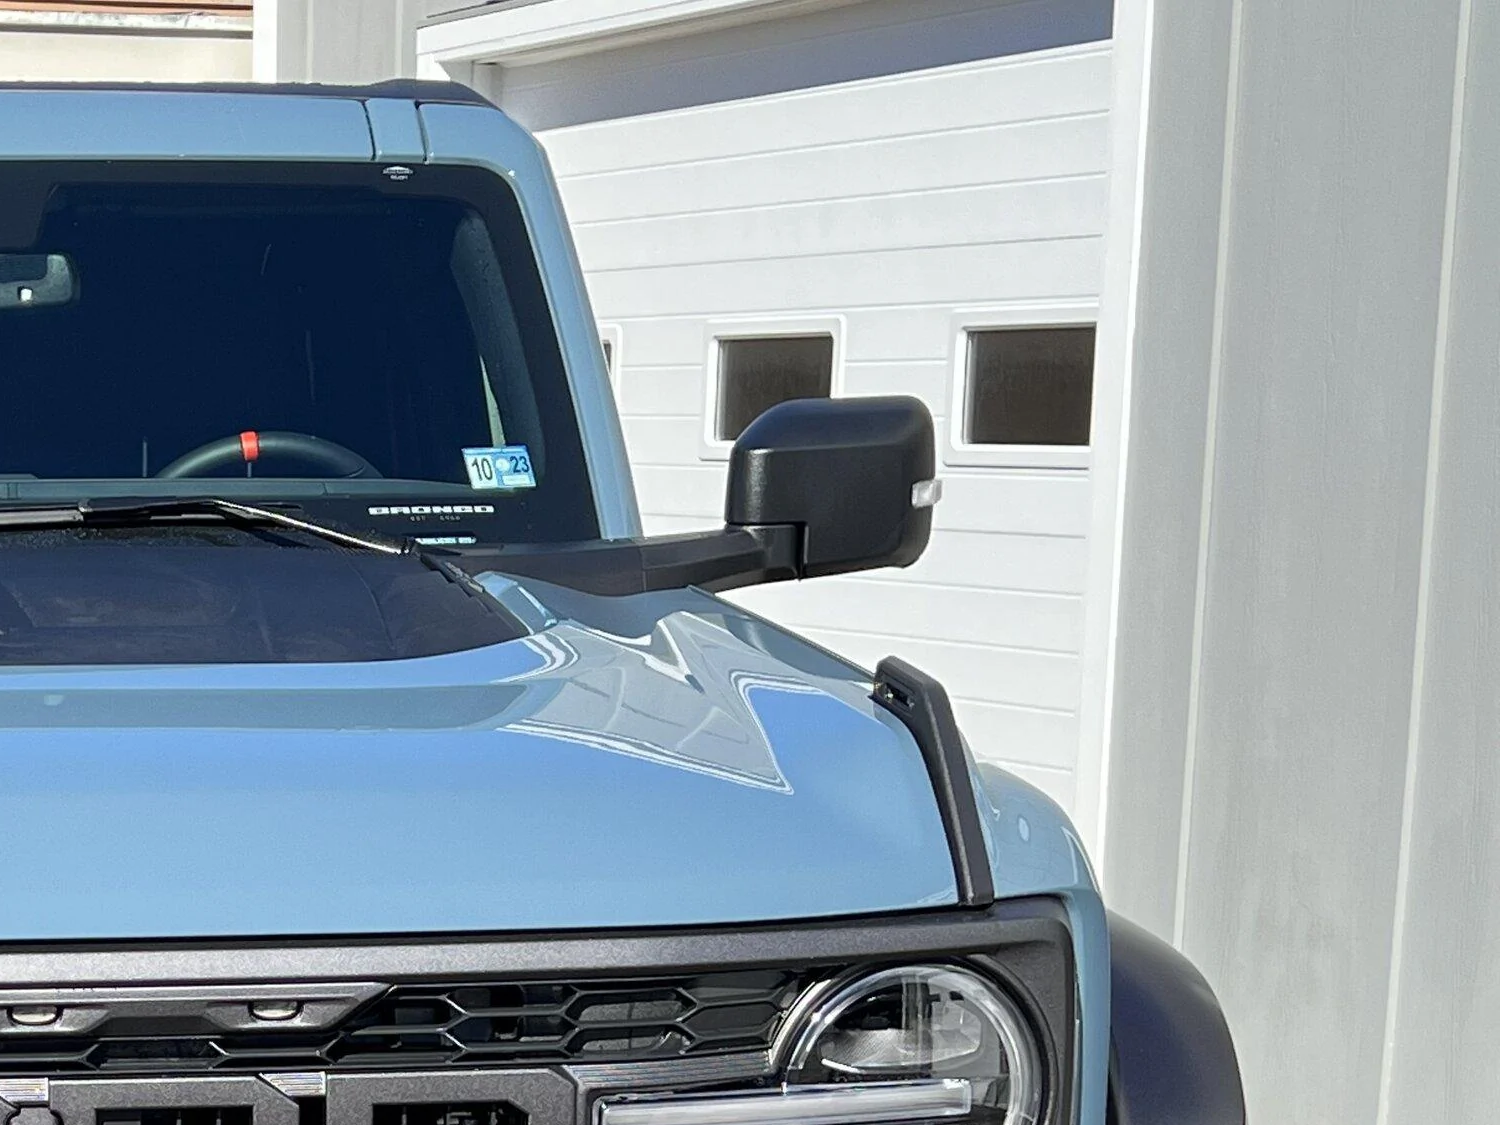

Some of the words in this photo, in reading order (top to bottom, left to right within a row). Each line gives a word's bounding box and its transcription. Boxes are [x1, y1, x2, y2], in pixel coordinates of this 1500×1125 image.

[472, 457, 492, 481] 10
[509, 456, 530, 473] 23
[368, 505, 495, 515] BRONCO
